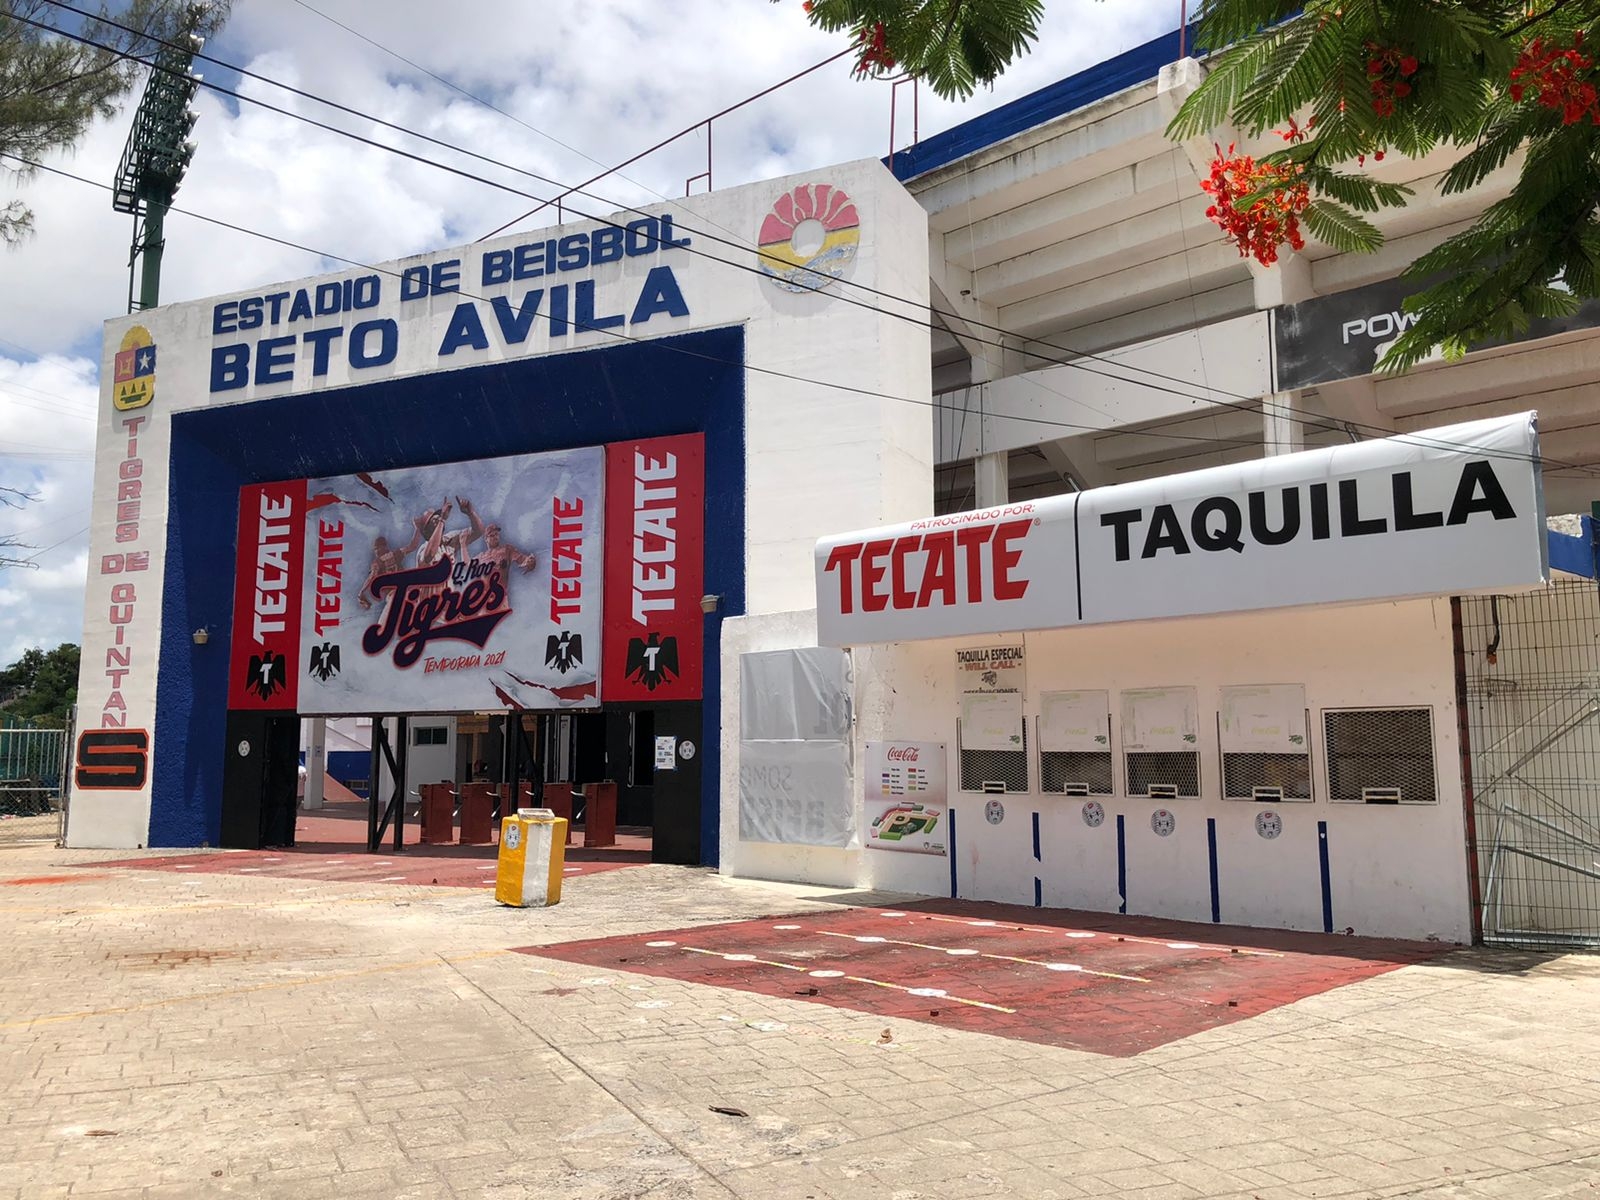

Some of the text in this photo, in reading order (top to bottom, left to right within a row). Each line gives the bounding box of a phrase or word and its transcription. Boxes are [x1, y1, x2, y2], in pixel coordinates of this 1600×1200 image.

[210, 266, 690, 392] BETO AVILA
[213, 214, 691, 335] ESTADIO DE BEISBOL
[115, 416, 146, 543] TIGRES
[910, 504, 1036, 531] PATROCINADO POR:
[1100, 460, 1517, 561] TAQUILLA
[101, 551, 149, 575] DE
[253, 493, 292, 645] TECATE
[315, 519, 344, 637] TECATE
[550, 496, 583, 625] TECATE
[632, 451, 677, 626] TECATE
[824, 518, 1033, 614] TECATE
[362, 553, 512, 669] Tigres
[424, 651, 506, 673] TEMPORADA 2021
[957, 647, 1023, 663] TAQUILLA ESPECIAL
[964, 660, 1016, 671] WILL CALL
